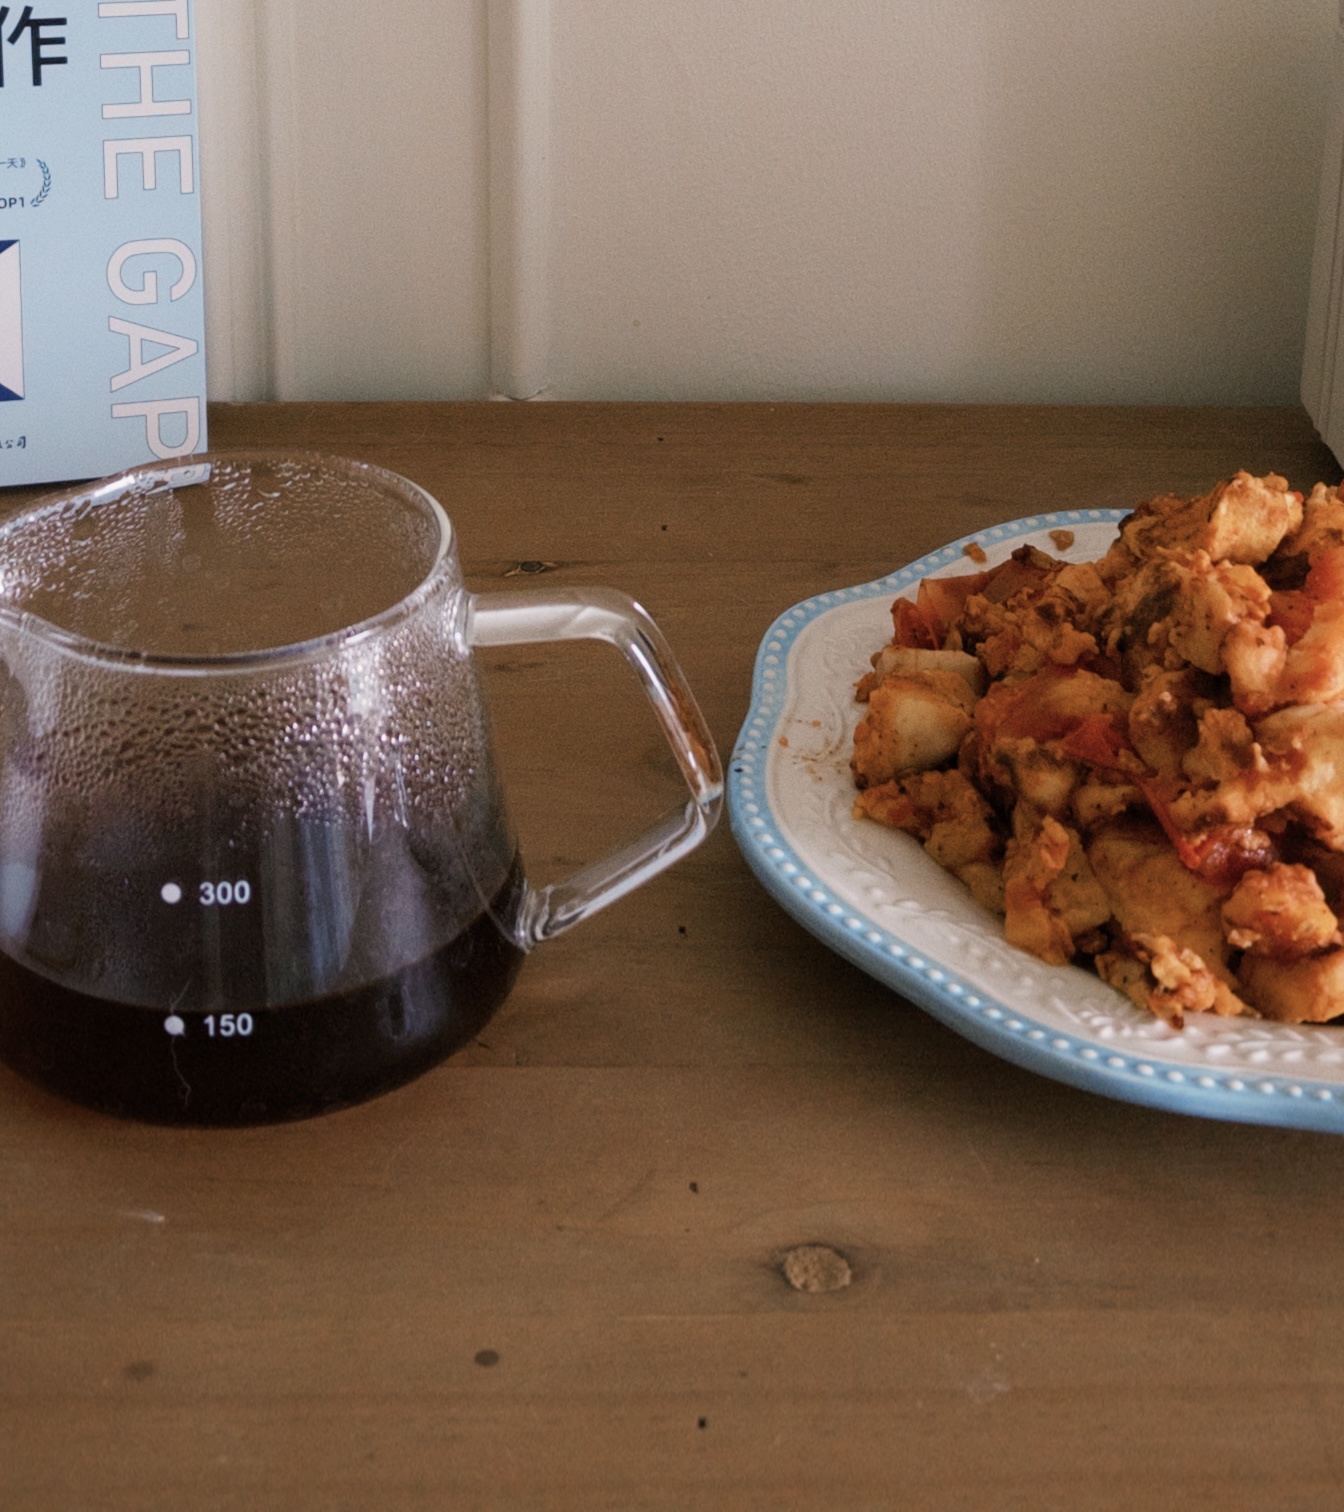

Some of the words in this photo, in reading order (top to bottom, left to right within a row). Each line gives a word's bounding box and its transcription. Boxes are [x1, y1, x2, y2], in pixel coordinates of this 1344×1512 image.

[106, 237, 200, 460] GAP
[199, 879, 252, 906] 300
[203, 1012, 254, 1037] 150
